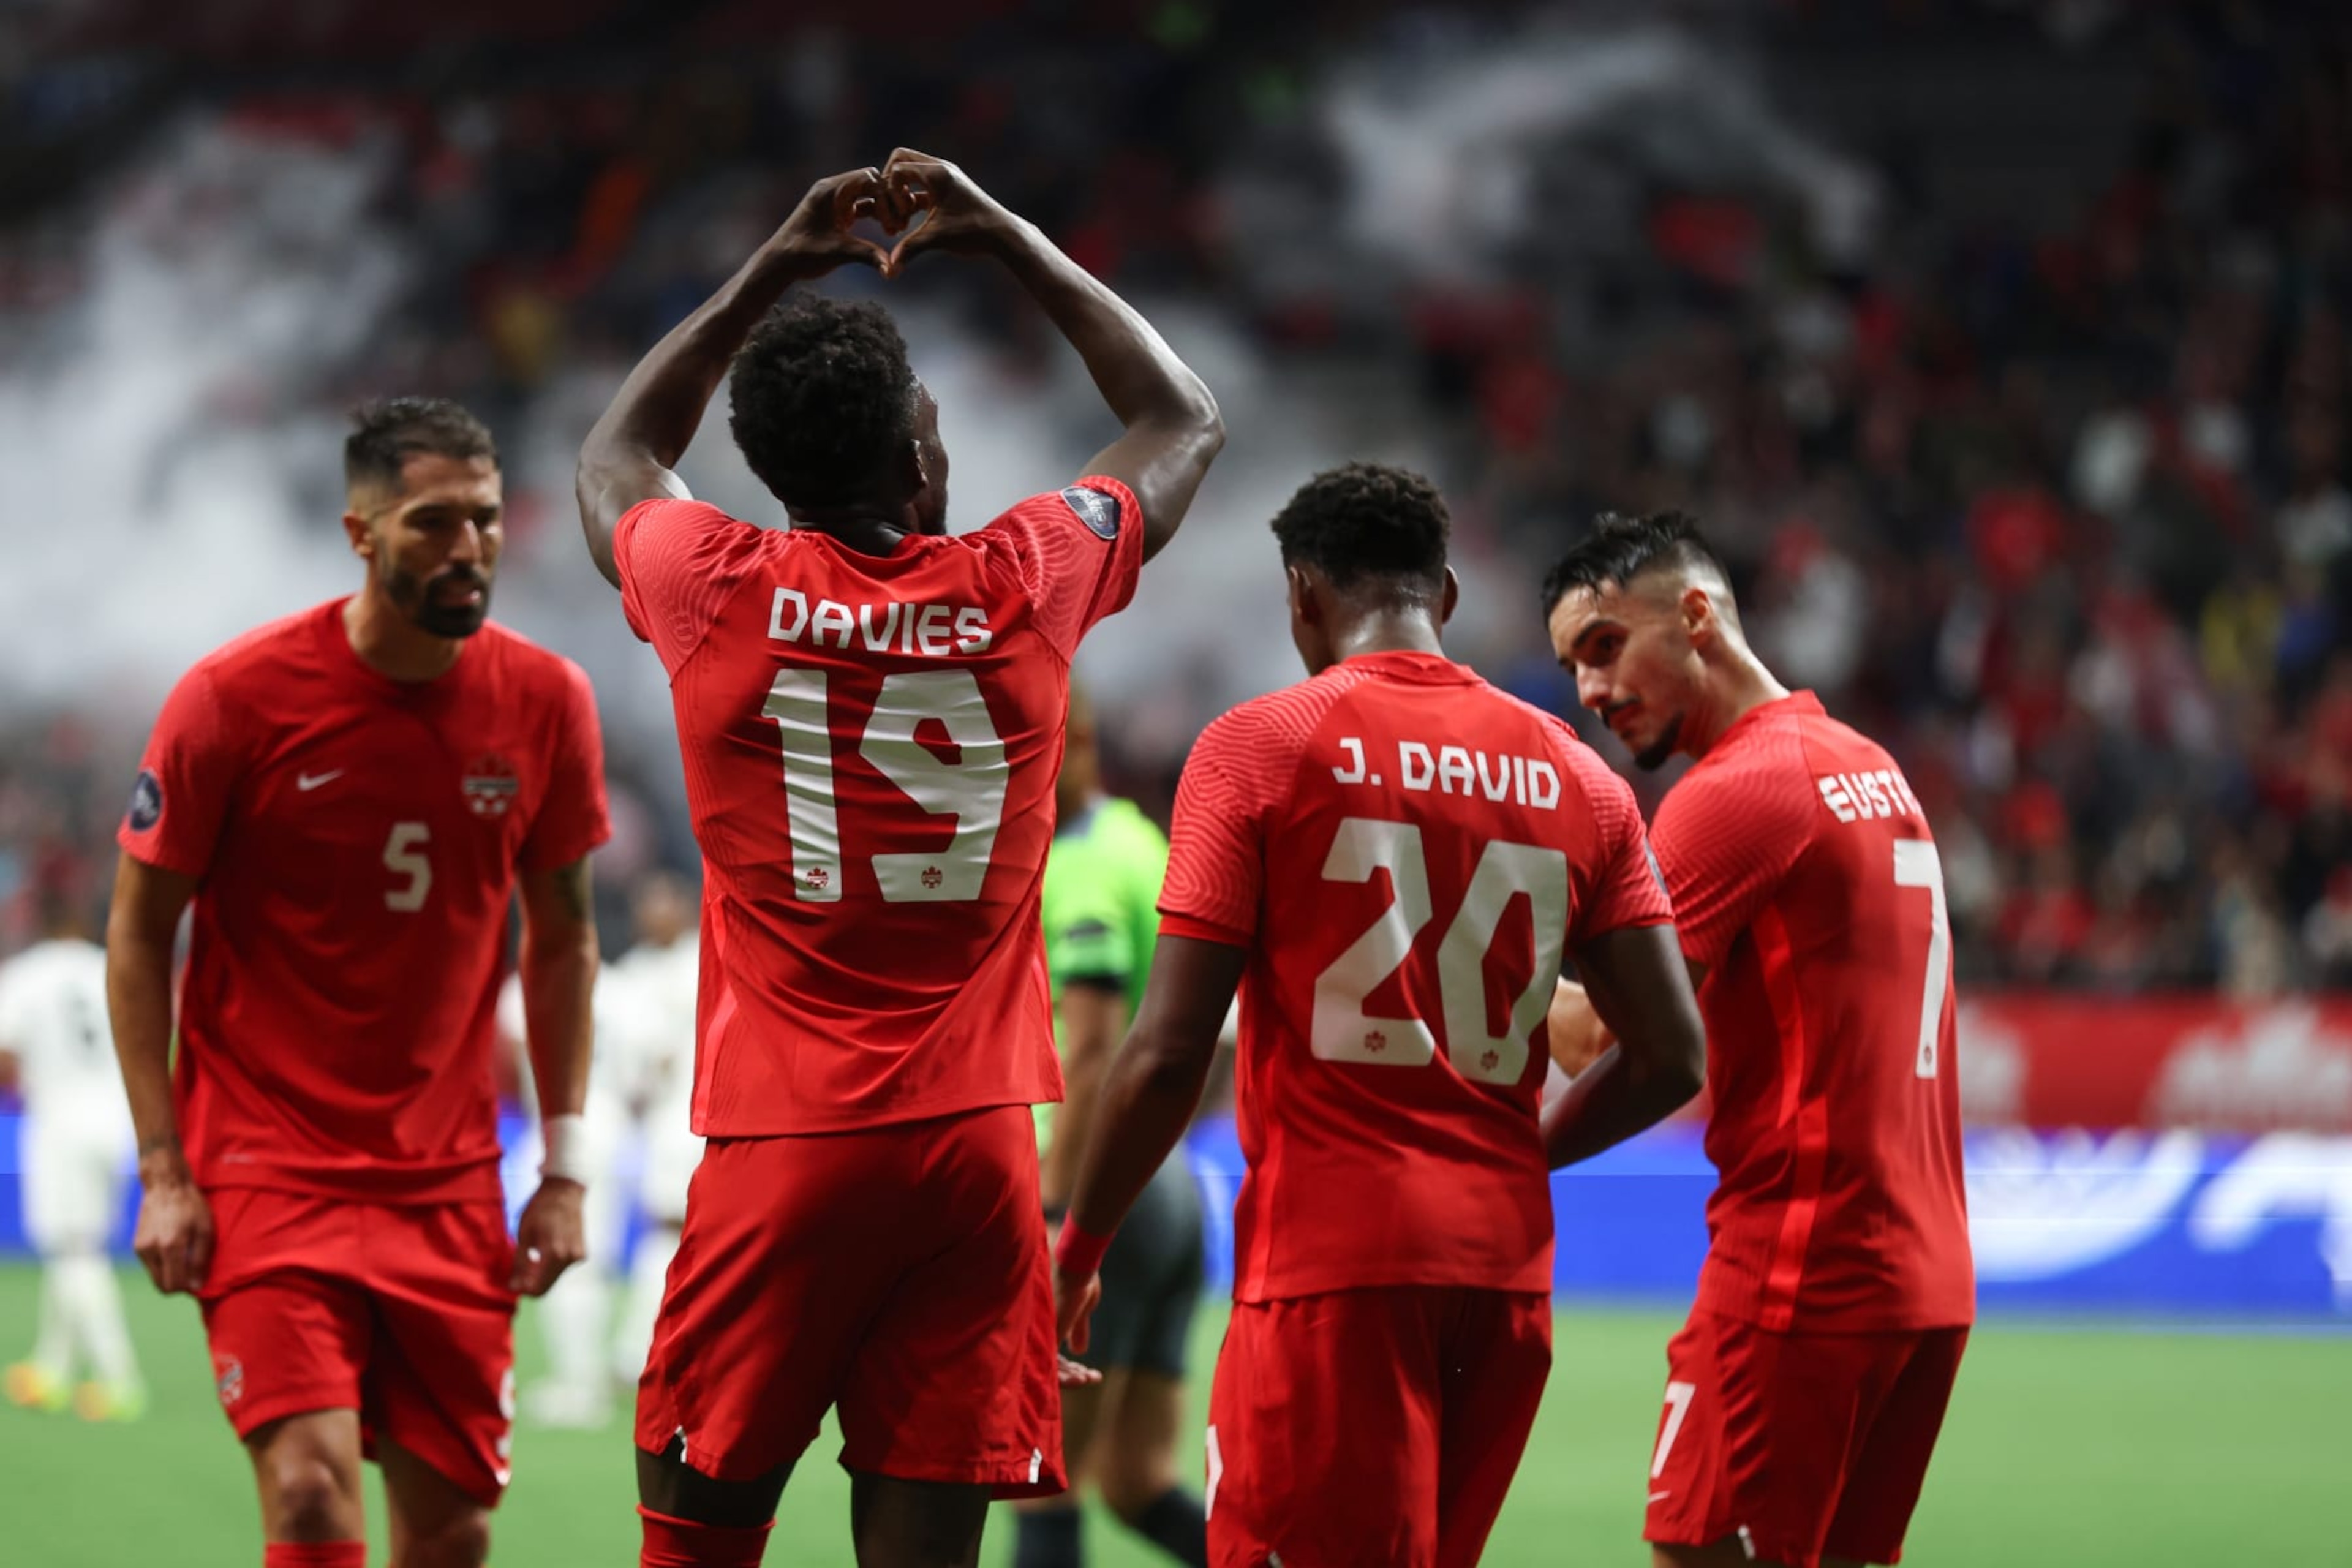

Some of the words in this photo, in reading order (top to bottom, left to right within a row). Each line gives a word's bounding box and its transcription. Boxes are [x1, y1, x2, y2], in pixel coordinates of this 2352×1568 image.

[768, 586, 993, 655] DAVIES
[761, 668, 1010, 902] 19
[1331, 737, 1382, 786] J.
[1398, 741, 1561, 810] DAVID
[384, 821, 432, 912] 5
[1310, 816, 1569, 1086] 20
[1893, 837, 1949, 1079] 7
[1651, 1381, 1696, 1479] 7
